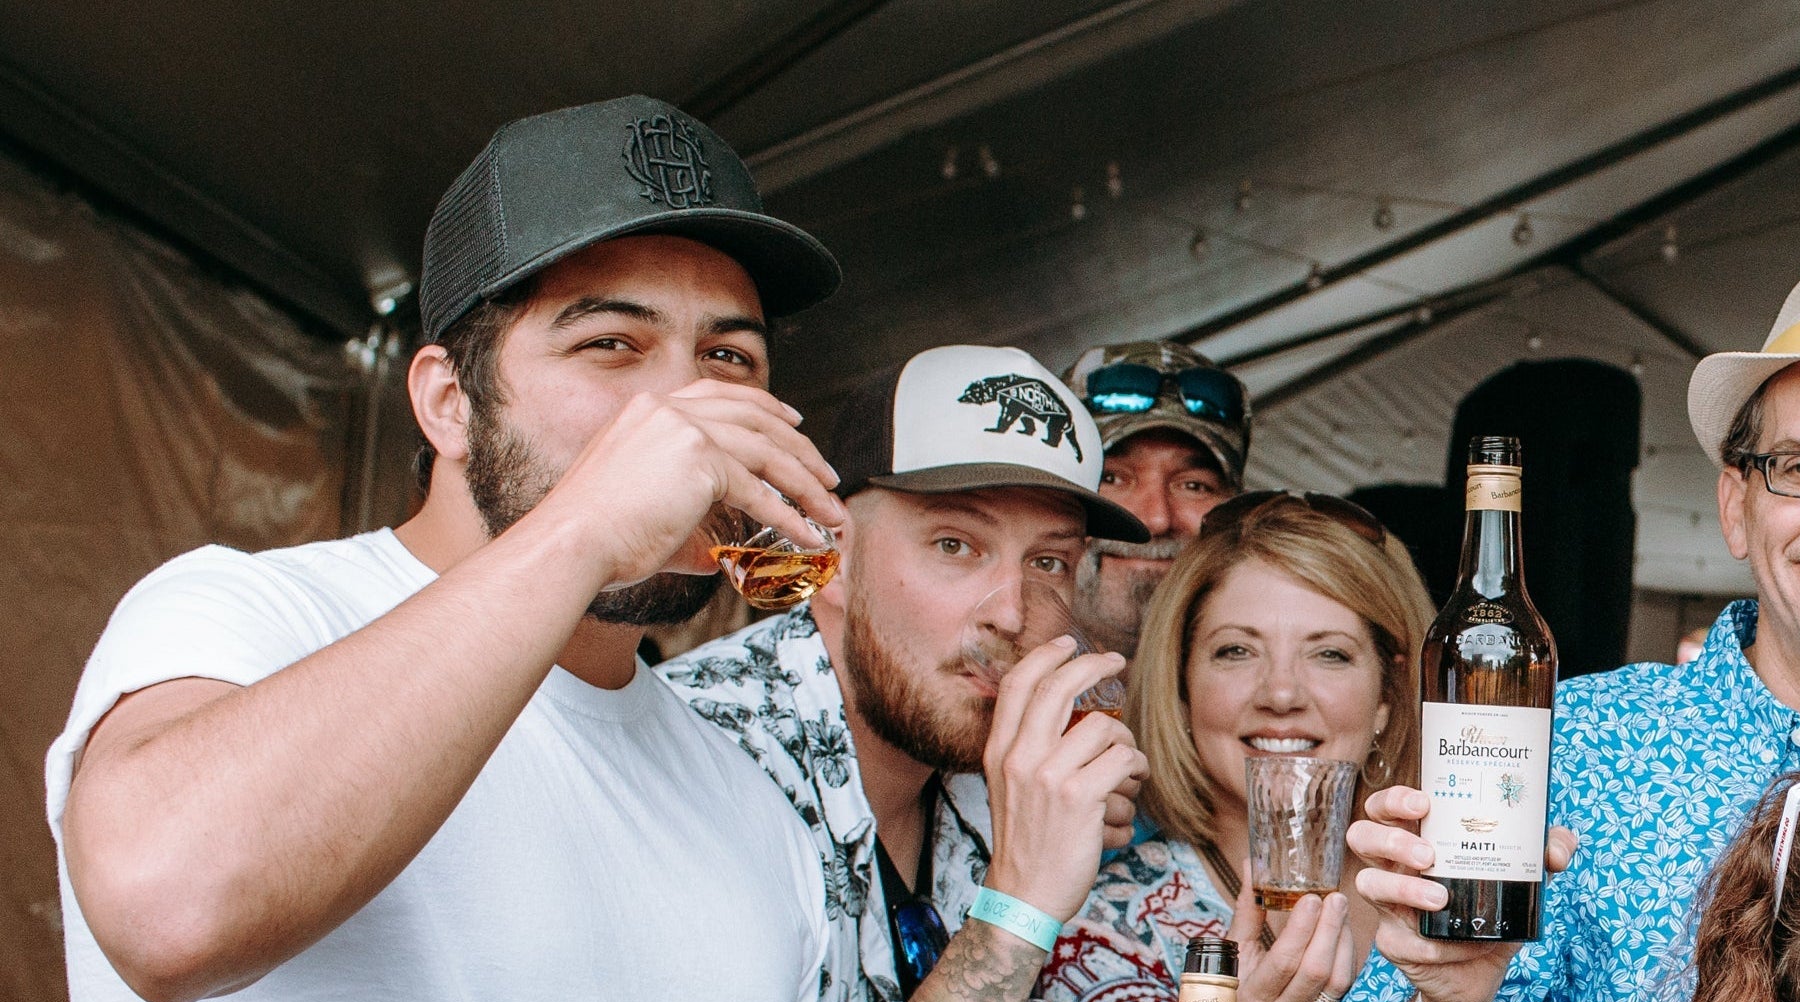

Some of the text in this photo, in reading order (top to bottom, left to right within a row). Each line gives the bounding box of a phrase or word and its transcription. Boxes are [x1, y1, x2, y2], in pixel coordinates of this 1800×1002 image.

[1472, 609, 1502, 618] 1862
[1439, 738, 1529, 759] Barbancourt
[1448, 773, 1456, 788] 8
[1461, 841, 1496, 851] HAITI
